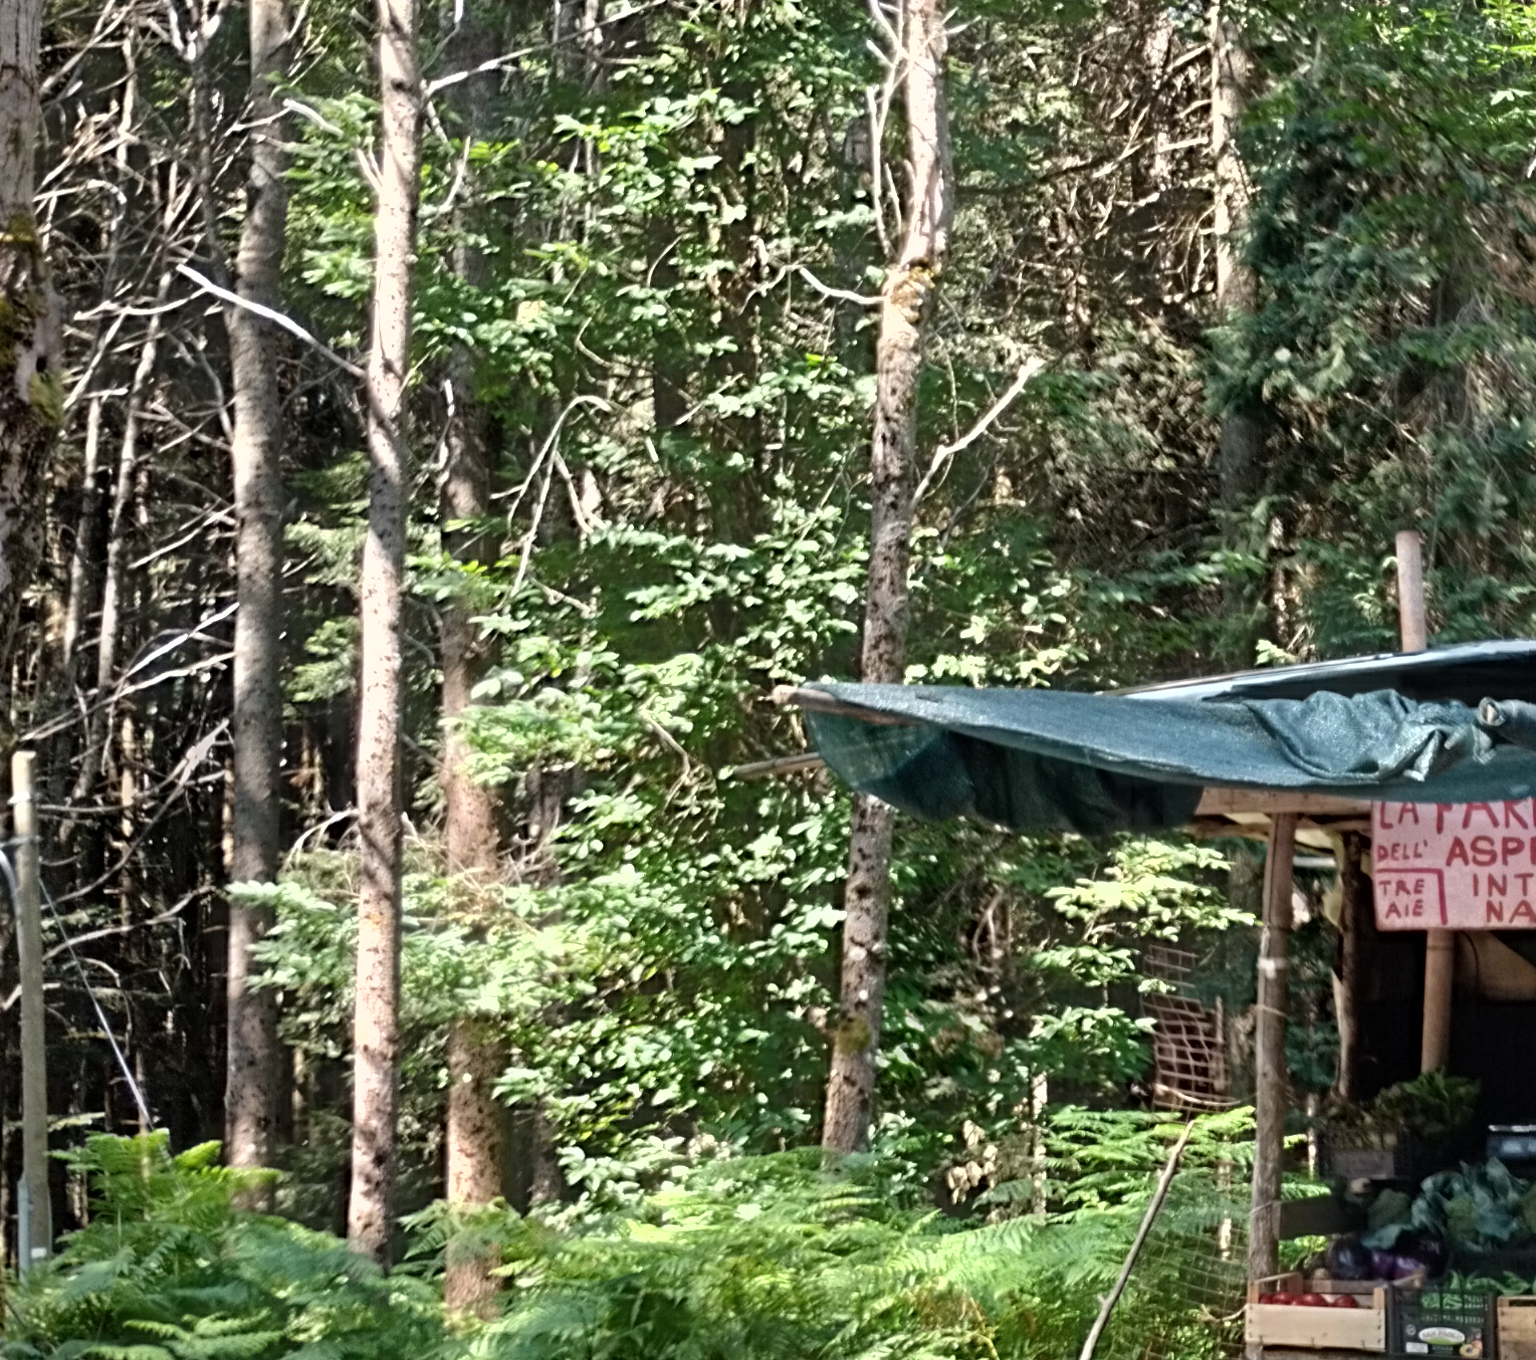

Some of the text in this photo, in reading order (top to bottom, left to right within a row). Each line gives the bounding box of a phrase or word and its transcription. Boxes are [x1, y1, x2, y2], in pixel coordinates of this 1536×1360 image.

[1379, 801, 1419, 830] LA
[1376, 839, 1428, 862] DELL'
[1378, 878, 1425, 896] TRE
[1385, 898, 1424, 920] AIE
